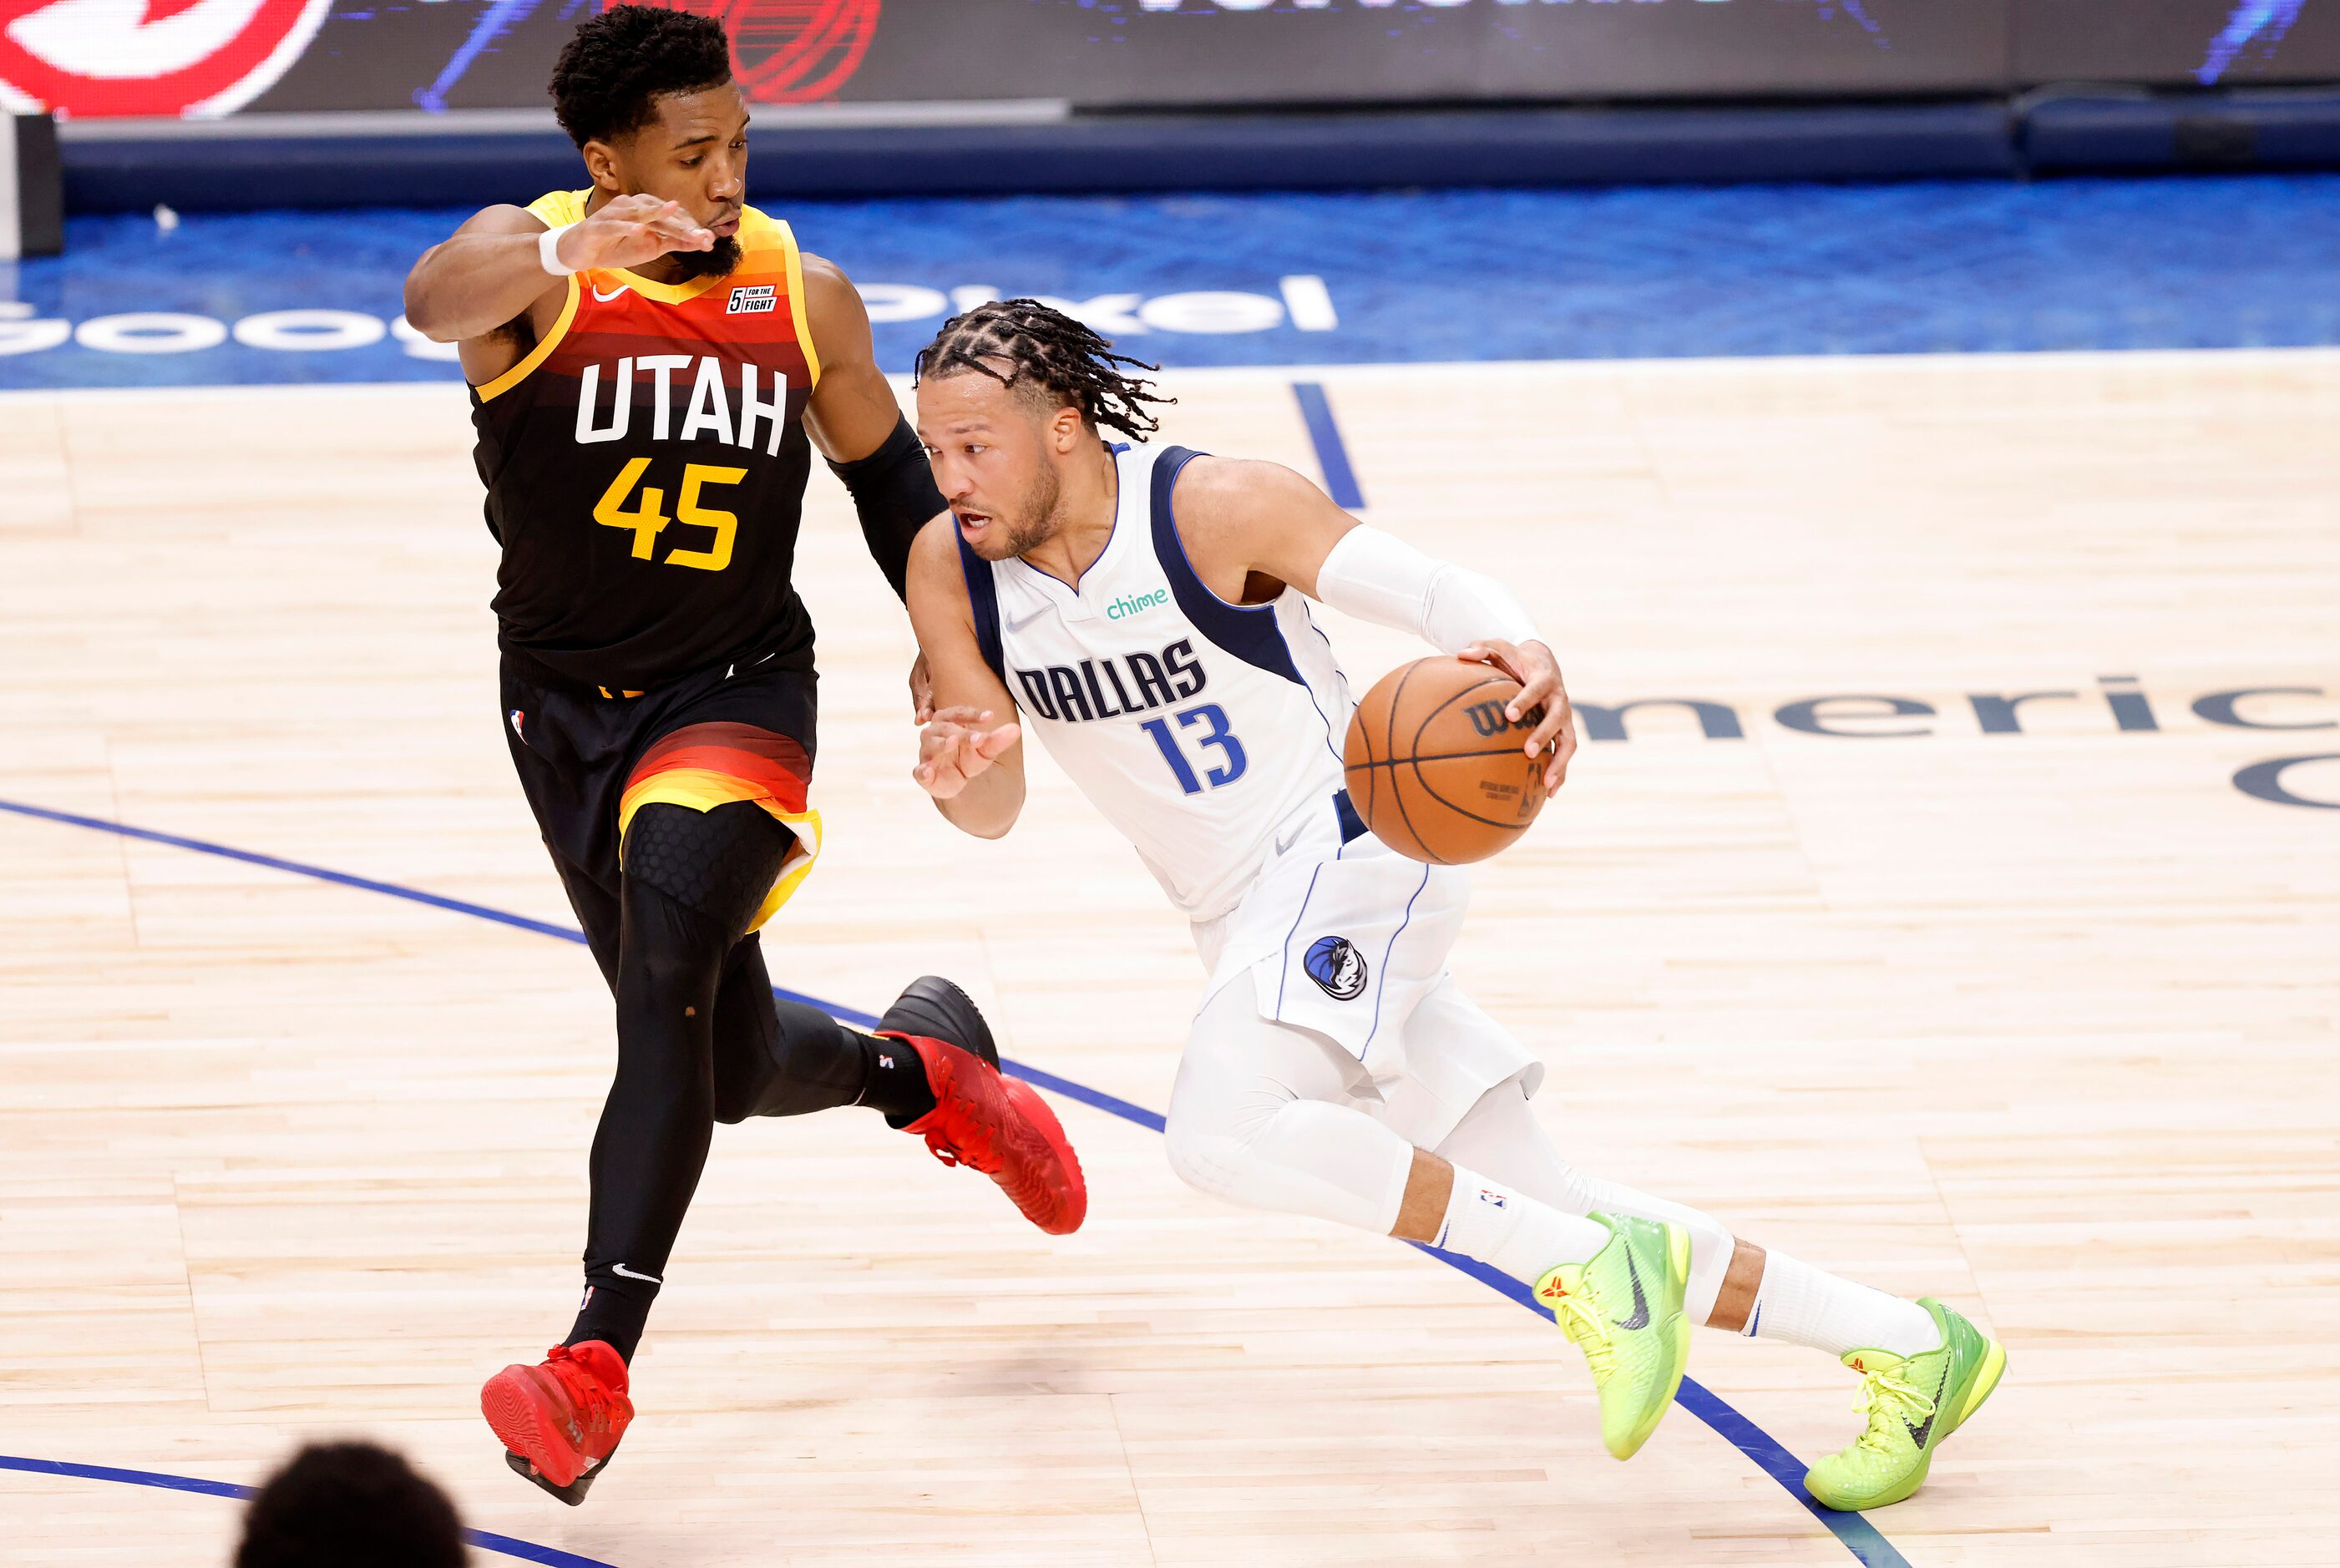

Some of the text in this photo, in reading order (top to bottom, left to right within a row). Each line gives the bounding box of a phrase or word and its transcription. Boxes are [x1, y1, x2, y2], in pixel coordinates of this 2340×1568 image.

[730, 290, 743, 311] 5
[745, 299, 773, 311] FIGHT
[575, 354, 788, 458] UTAH
[593, 457, 749, 571] 45
[1107, 589, 1168, 620] chime
[1015, 636, 1208, 724] DALLAS
[1137, 701, 1249, 797] 13
